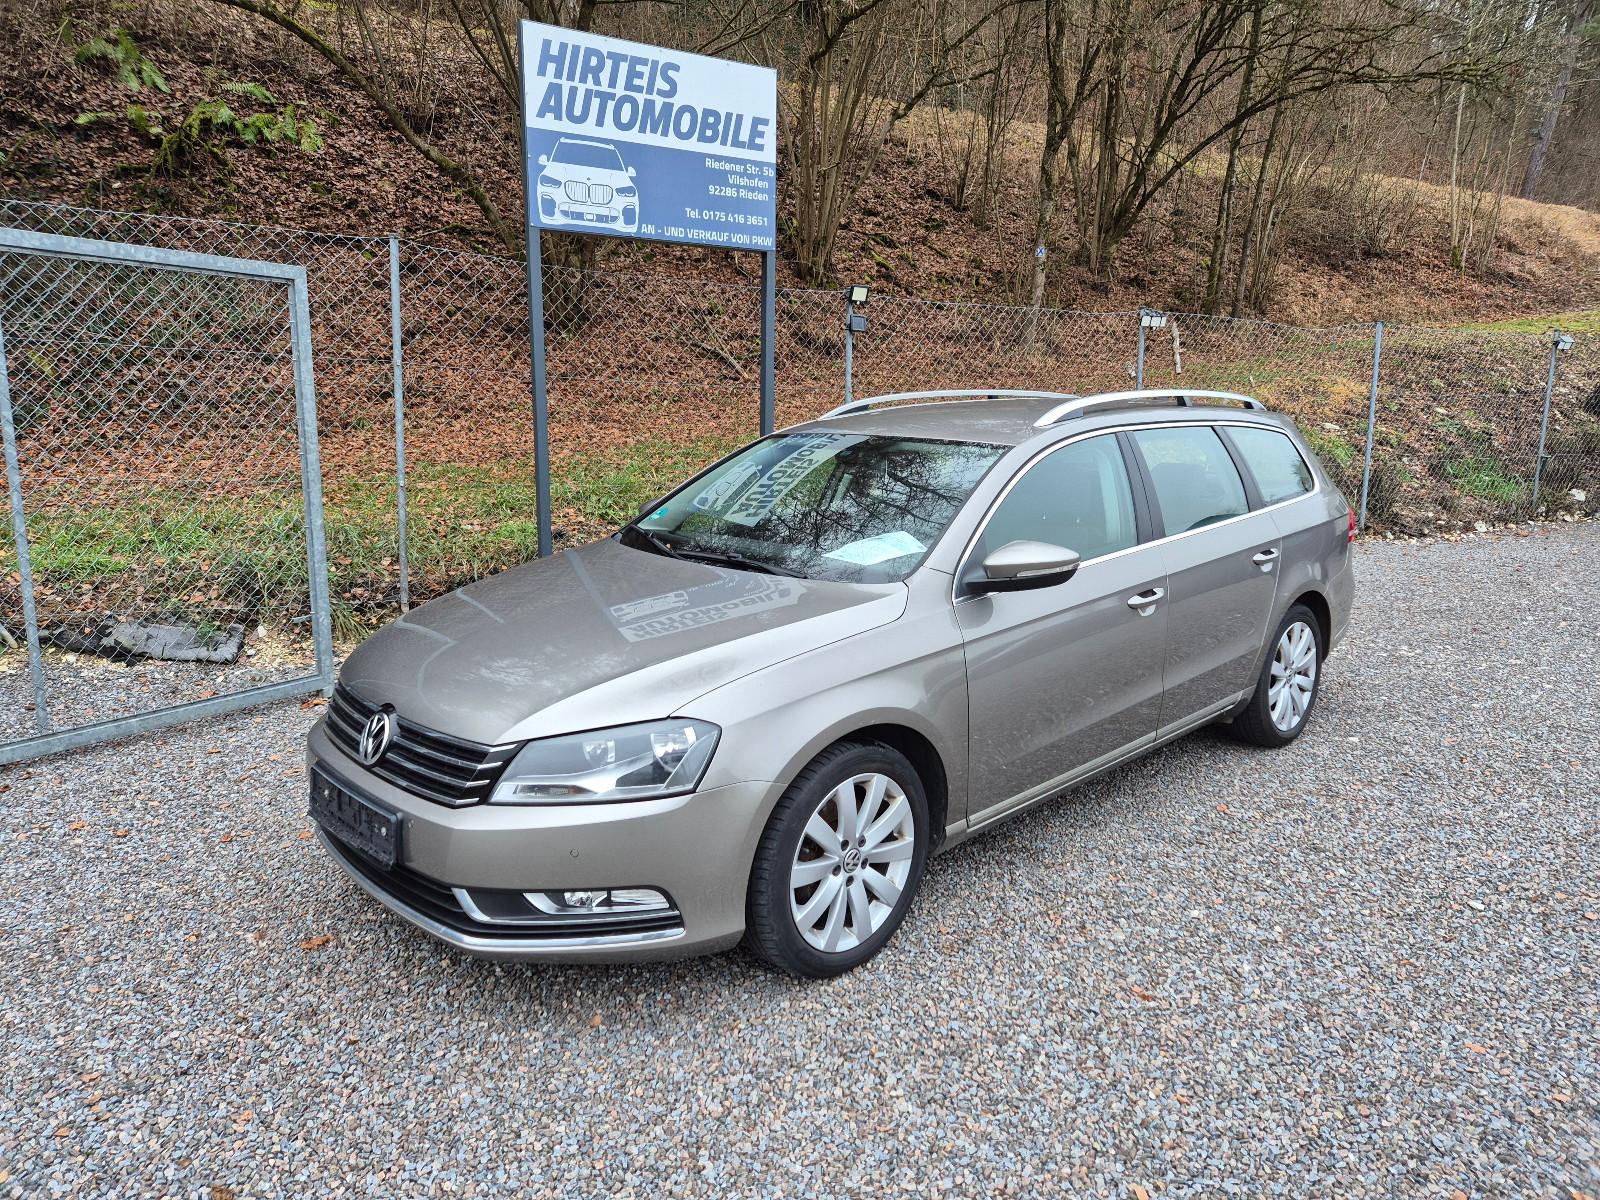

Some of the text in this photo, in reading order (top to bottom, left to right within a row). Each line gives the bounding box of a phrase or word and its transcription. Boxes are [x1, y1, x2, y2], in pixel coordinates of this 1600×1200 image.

[536, 38, 681, 99] HIRTEIS
[535, 81, 770, 152] AUTOMOBILE
[705, 157, 775, 177] Riedener Str. 5b
[727, 174, 769, 189] Vilshofen
[708, 185, 768, 201] 92286 Rieden
[685, 207, 768, 226] Tel. 0175 416 3651
[641, 223, 655, 235] AN
[664, 226, 685, 238] UND
[687, 228, 729, 242] VERKAUF
[730, 233, 750, 245] VON
[752, 236, 773, 246] PKW
